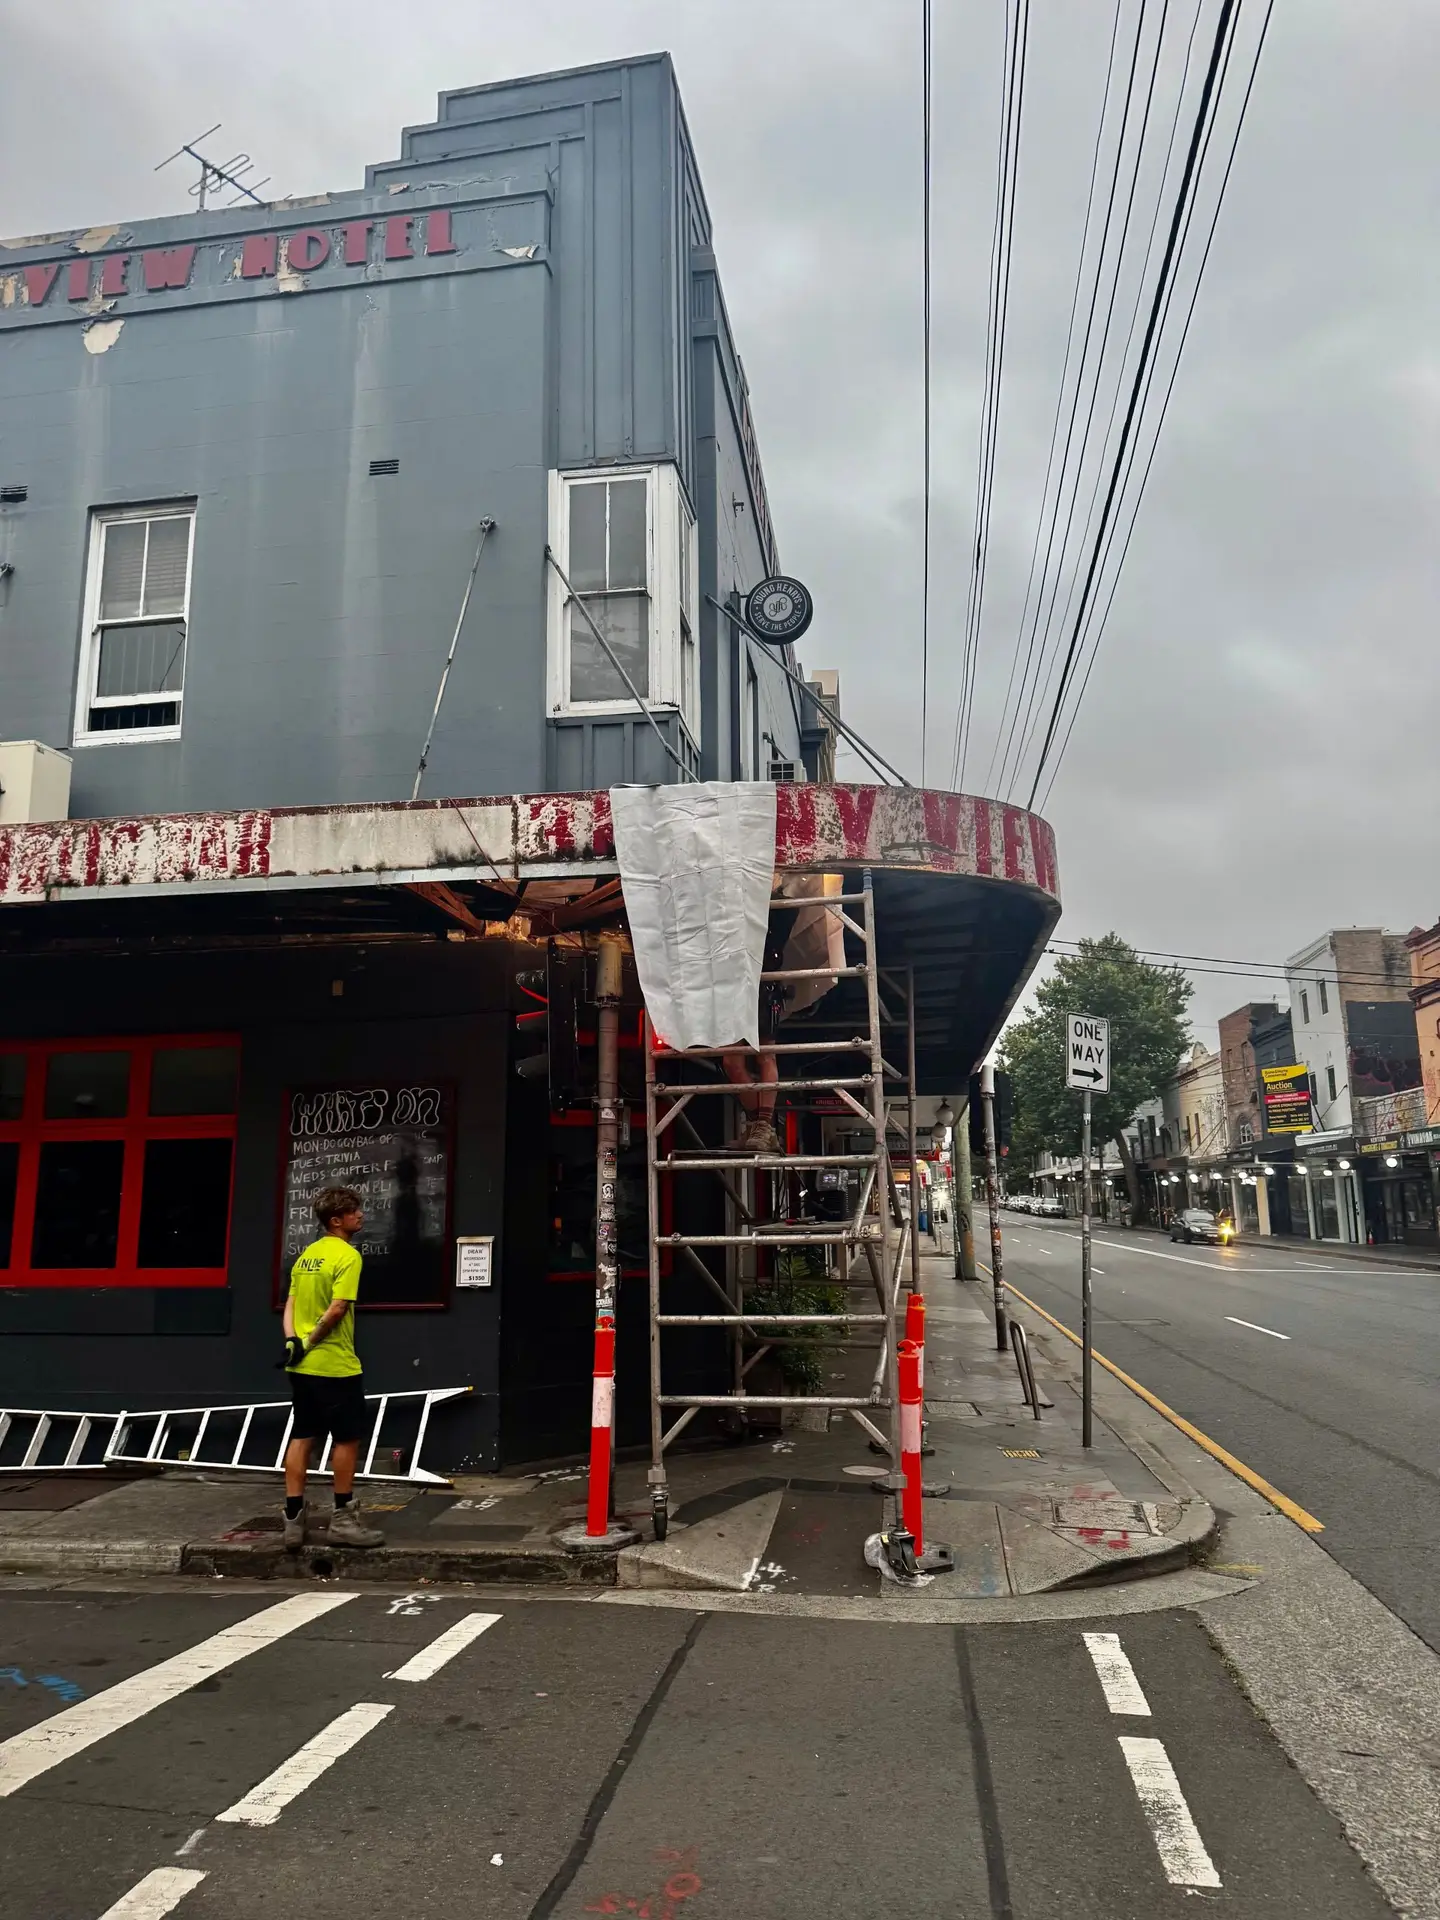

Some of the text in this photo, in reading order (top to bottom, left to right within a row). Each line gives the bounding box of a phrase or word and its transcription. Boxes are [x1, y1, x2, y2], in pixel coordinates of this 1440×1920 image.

[24, 209, 459, 308] VIEW HOTEL
[753, 583, 803, 605] YOUNG HENRYS
[754, 609, 802, 631] SERVE THE PEOPLE
[1074, 1021, 1103, 1042] ONE
[1072, 1043, 1104, 1064] WAY
[1266, 1081, 1293, 1091] Auction
[325, 1151, 361, 1165] TRIVIA
